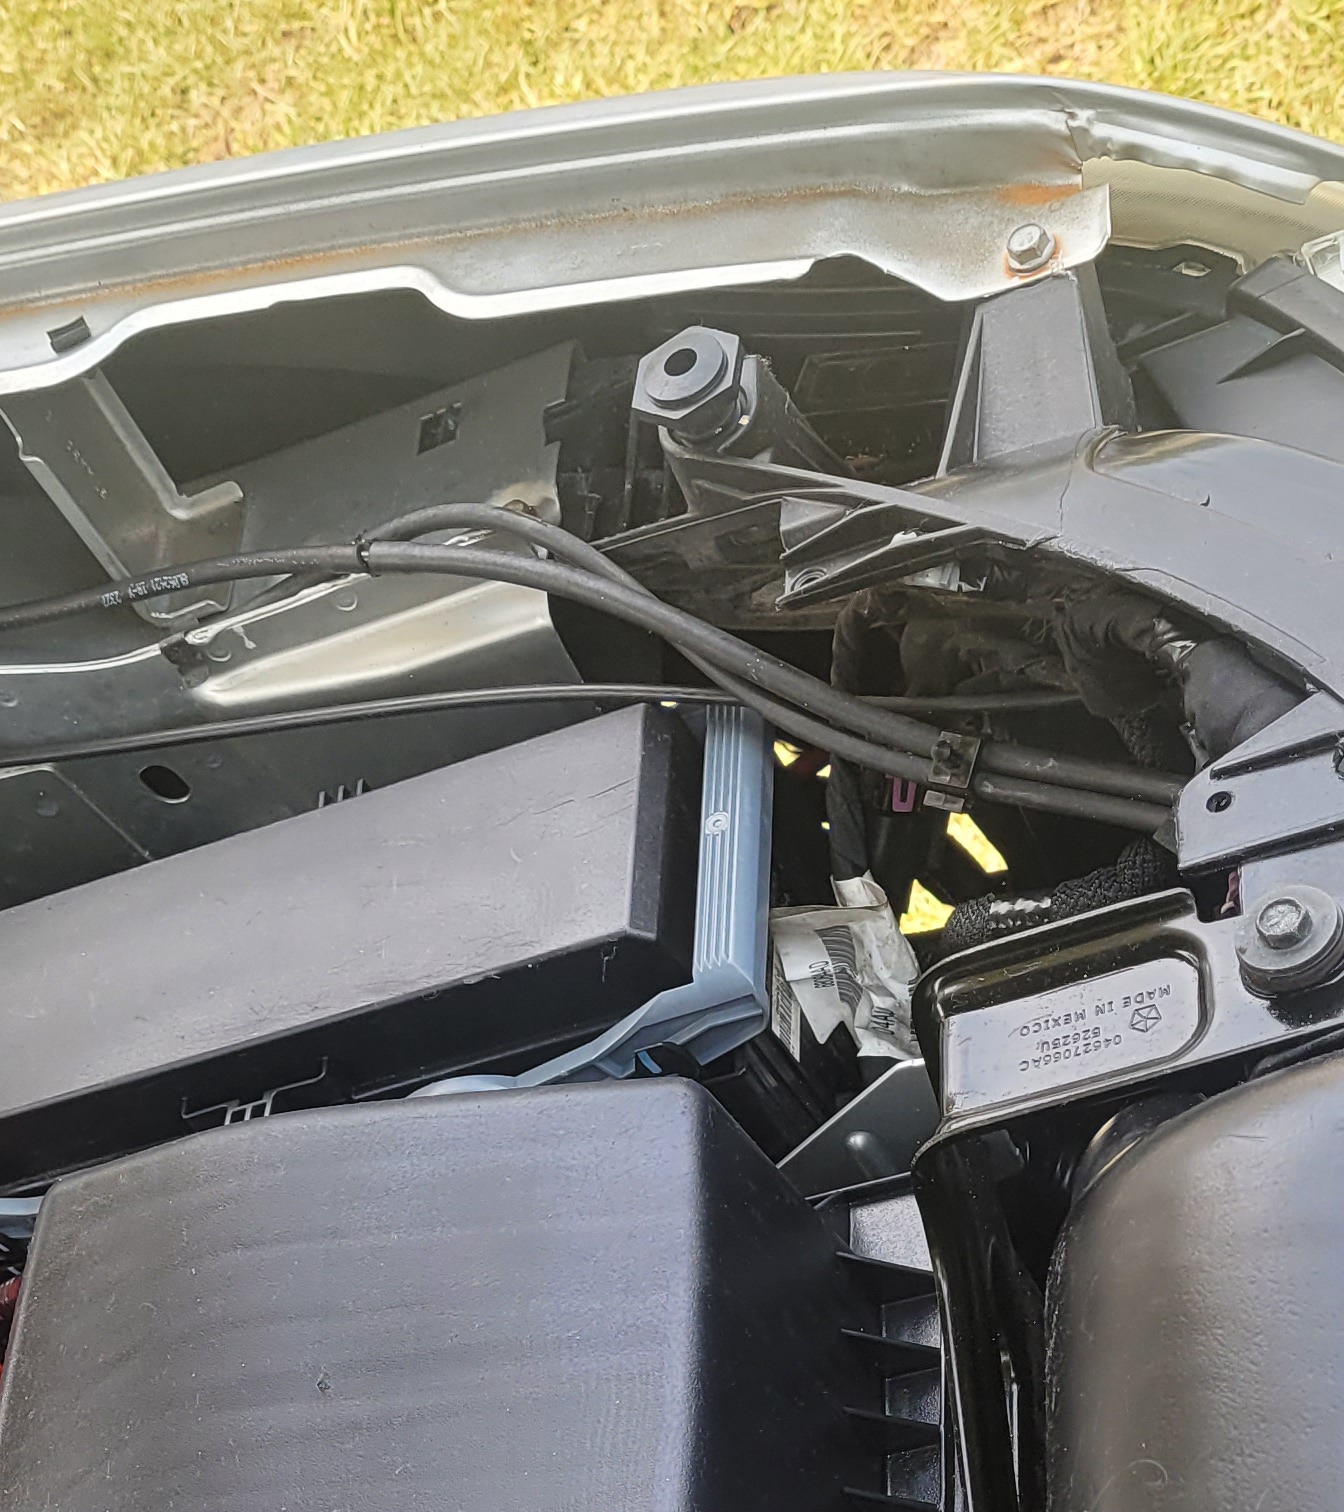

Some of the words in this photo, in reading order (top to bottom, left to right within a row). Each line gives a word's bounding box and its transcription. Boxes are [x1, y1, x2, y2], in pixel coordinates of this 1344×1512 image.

[1094, 1001, 1114, 1016] IN
[1122, 984, 1172, 1009] MADE
[1018, 1008, 1086, 1037] MEXICO
